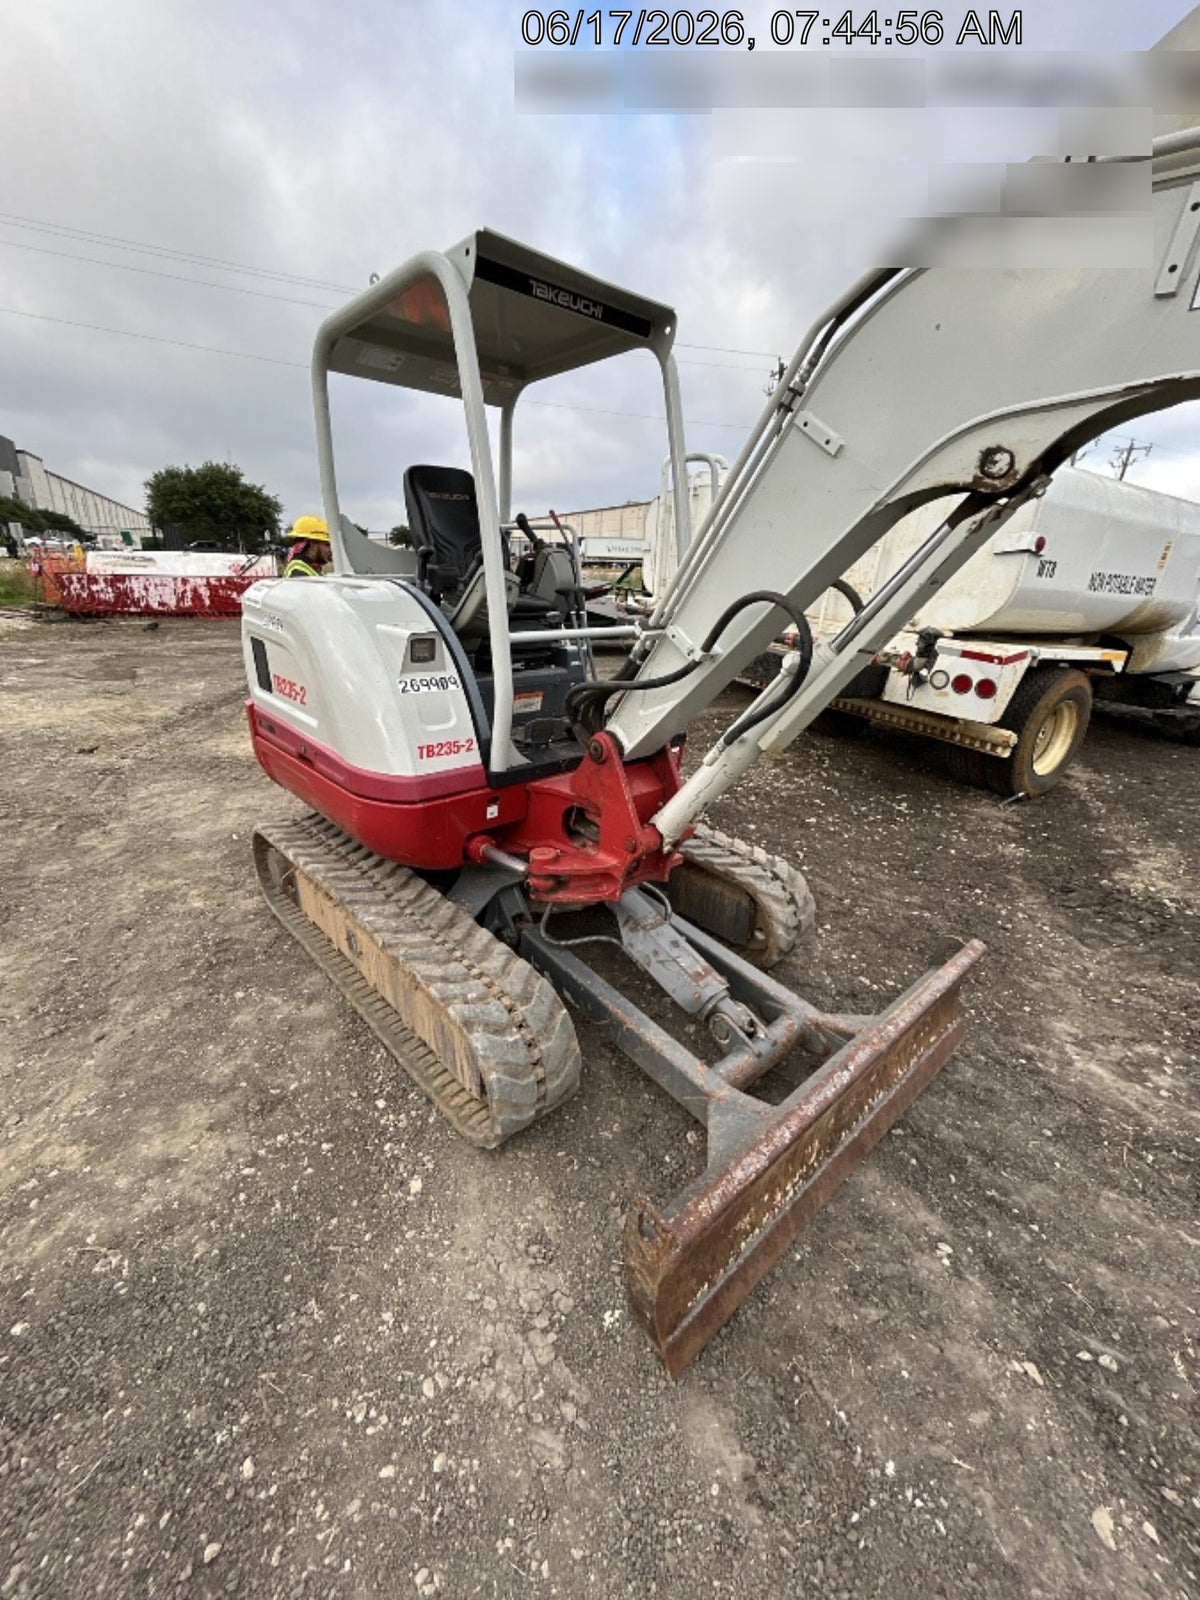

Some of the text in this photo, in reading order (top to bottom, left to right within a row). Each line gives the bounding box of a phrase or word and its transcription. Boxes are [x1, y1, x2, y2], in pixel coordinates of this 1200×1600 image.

[1088, 571, 1157, 596] NON POTABLE WATER
[272, 673, 307, 706] TB235-2
[417, 738, 475, 760] TB235-2
